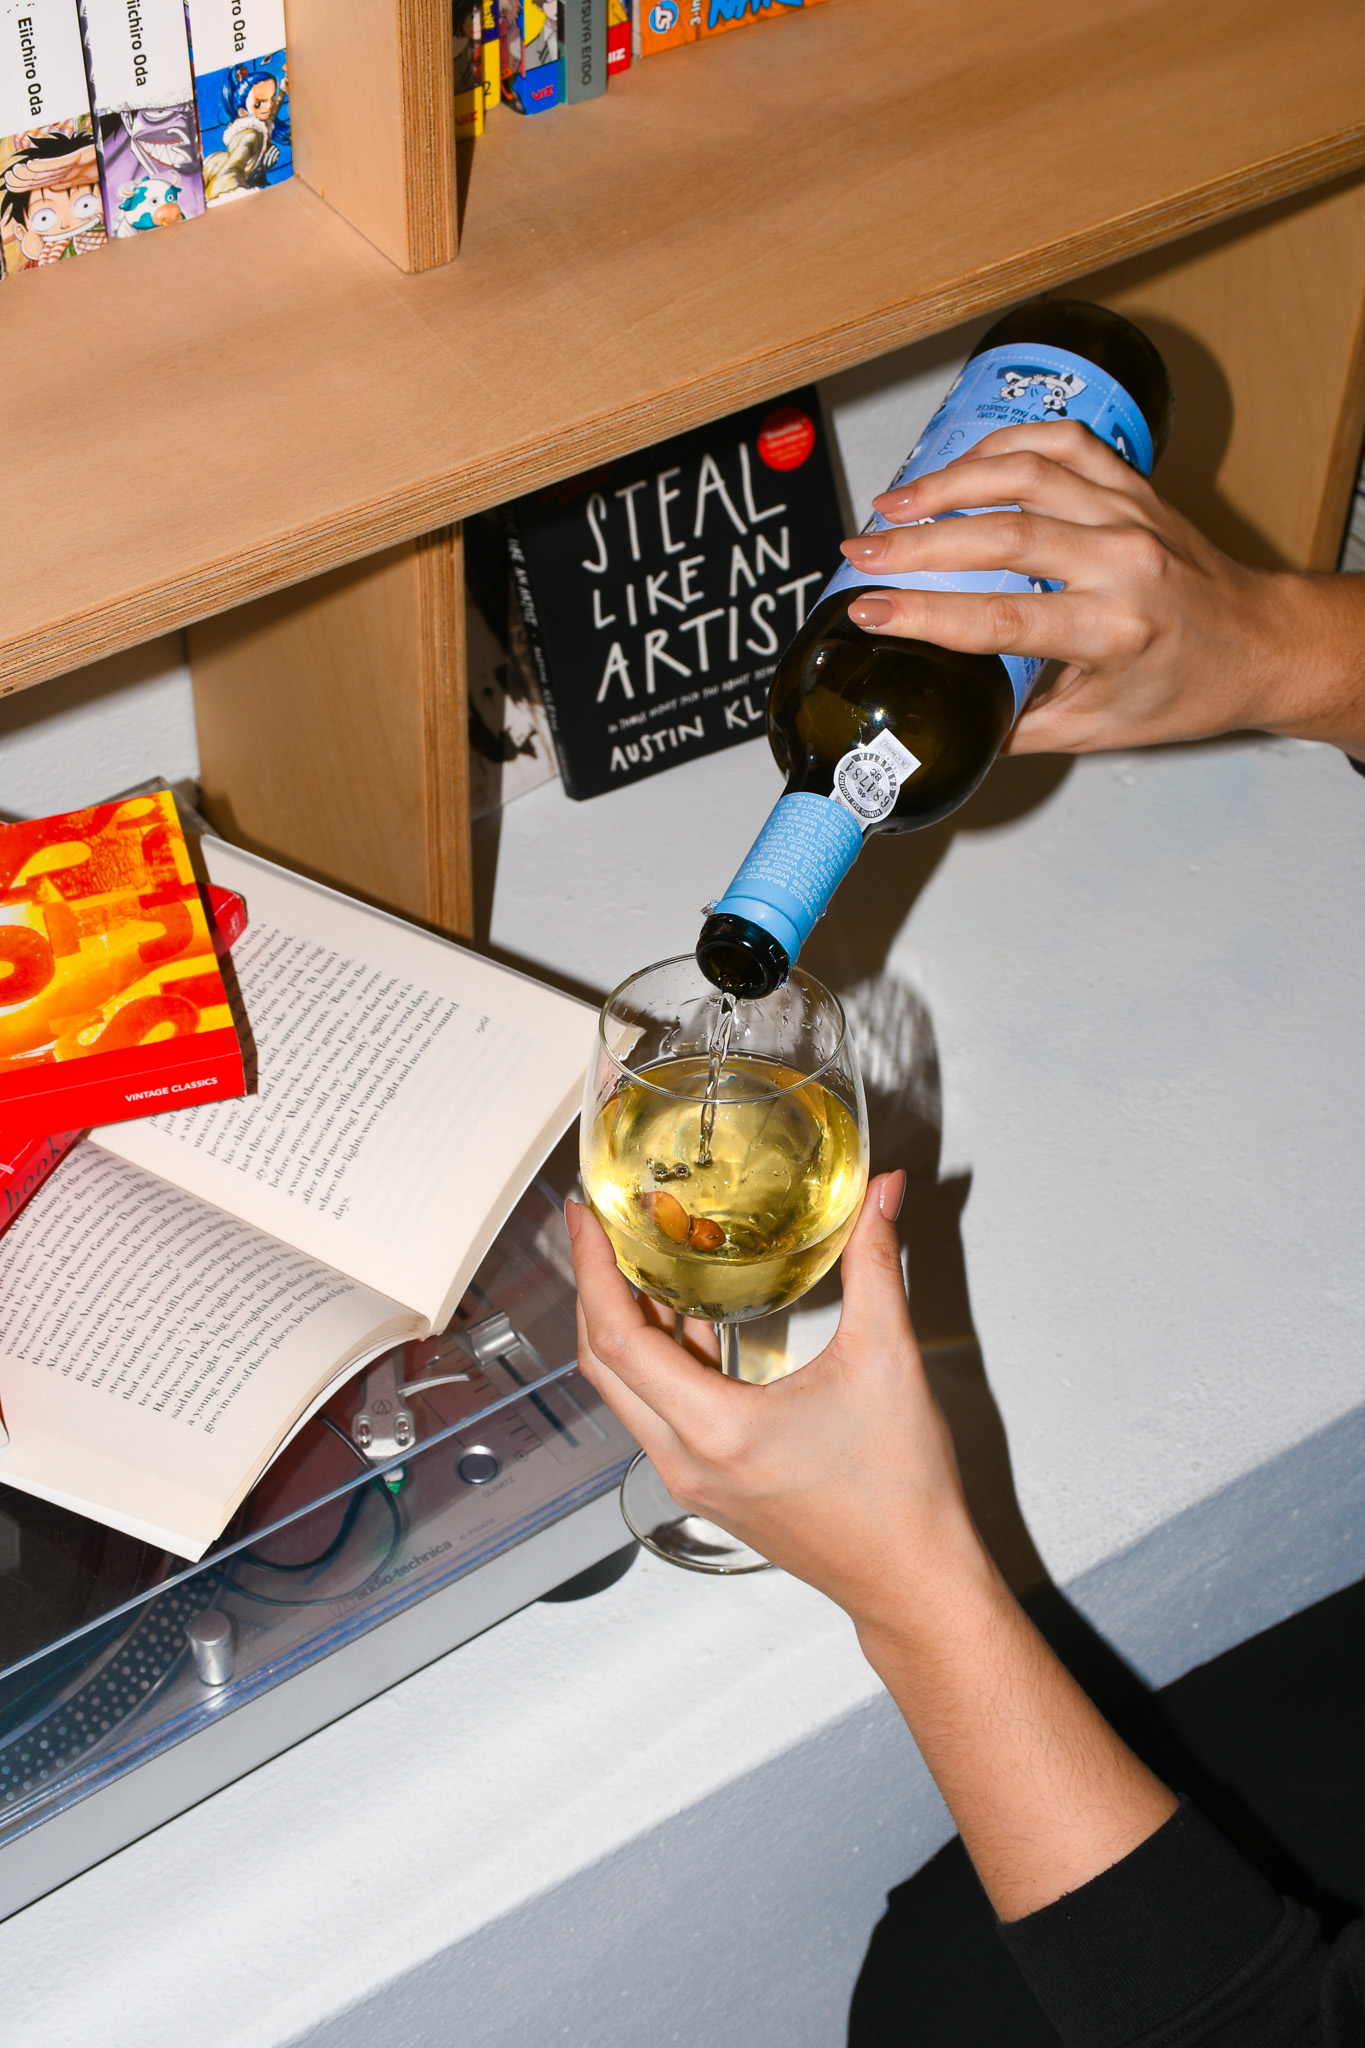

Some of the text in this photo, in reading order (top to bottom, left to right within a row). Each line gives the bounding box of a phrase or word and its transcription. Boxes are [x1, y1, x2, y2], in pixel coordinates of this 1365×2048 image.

[233, 20, 246, 52] Oda
[18, 17, 43, 116] Eiichiro Oda
[133, 54, 148, 87] Oda
[581, 46, 592, 86] ENDO
[531, 85, 555, 100] VIZ
[582, 442, 787, 573] STEAL
[593, 526, 789, 629] LIKE AN
[596, 572, 822, 703] ARTIST
[701, 685, 719, 699] YOU
[721, 673, 751, 692] ABOUT
[610, 715, 705, 773] AUSTIN
[843, 760, 891, 808] 684784
[859, 753, 895, 790] GARANTIA
[789, 796, 829, 808] BRANCO
[838, 772, 882, 816] VINHO DO DOURO
[776, 821, 814, 834] BRANCO
[786, 814, 843, 851] WEISS WEISS
[796, 802, 852, 838] WHITE WHITE
[802, 809, 840, 835] BRANCO
[760, 848, 801, 860] BRANCO
[787, 835, 825, 861] BRANCO
[789, 843, 817, 864] WEISS
[798, 831, 825, 851] WHITE
[746, 874, 786, 887] BRANCO
[760, 867, 789, 880] WEISS
[767, 854, 822, 891] WHITE WHITE
[773, 862, 811, 888] BRANCO
[253, 1033, 268, 1047] the
[270, 1011, 286, 1030] cake
[221, 1149, 235, 1164] his
[256, 1082, 275, 1101] and
[269, 1068, 285, 1081] his
[343, 978, 356, 987] in
[353, 964, 366, 977] the
[125, 1077, 218, 1102] VINTAGE CLASSICS
[268, 1155, 290, 1187] before
[289, 1119, 310, 1154] anyone
[310, 1091, 330, 1118] could
[328, 1076, 342, 1091] say
[385, 998, 400, 1011] for
[290, 1160, 307, 1187] word
[308, 1113, 335, 1155] associate
[333, 1092, 351, 1111] with
[367, 1047, 382, 1065] and
[377, 1035, 391, 1048] for
[390, 1006, 414, 1035] several
[410, 990, 428, 1007] days
[302, 1179, 317, 1204] after
[314, 1157, 330, 1177] that
[327, 1116, 358, 1156] meeting
[357, 1074, 383, 1107] wanted
[381, 1057, 399, 1074] only
[394, 1045, 405, 1054] to
[400, 1032, 413, 1043] be
[410, 1022, 423, 1031] in
[421, 996, 443, 1022] places
[318, 1001, 459, 1210] where the lights were bright and no one counted
[122, 1380, 139, 1399] that
[137, 1361, 150, 1379] one
[147, 1352, 159, 1360] is
[157, 1327, 178, 1350] ready
[175, 1316, 187, 1325] to
[204, 1274, 225, 1292] these
[152, 1360, 194, 1412] Hollywood
[208, 1321, 229, 1336] big
[222, 1301, 245, 1321] favor
[241, 1291, 254, 1301] he
[254, 1279, 270, 1291] did
[192, 1386, 220, 1419] young
[215, 1365, 234, 1385] man
[232, 1320, 273, 1362] whispered
[270, 1313, 281, 1321] to
[281, 1301, 293, 1312] me
[203, 1410, 222, 1433] goes
[216, 1399, 230, 1409] in
[228, 1381, 242, 1398] one
[241, 1368, 252, 1380] of
[248, 1347, 269, 1369] those
[483, 1476, 516, 1499] QUARTZ
[357, 1539, 453, 1600] audio-technica
